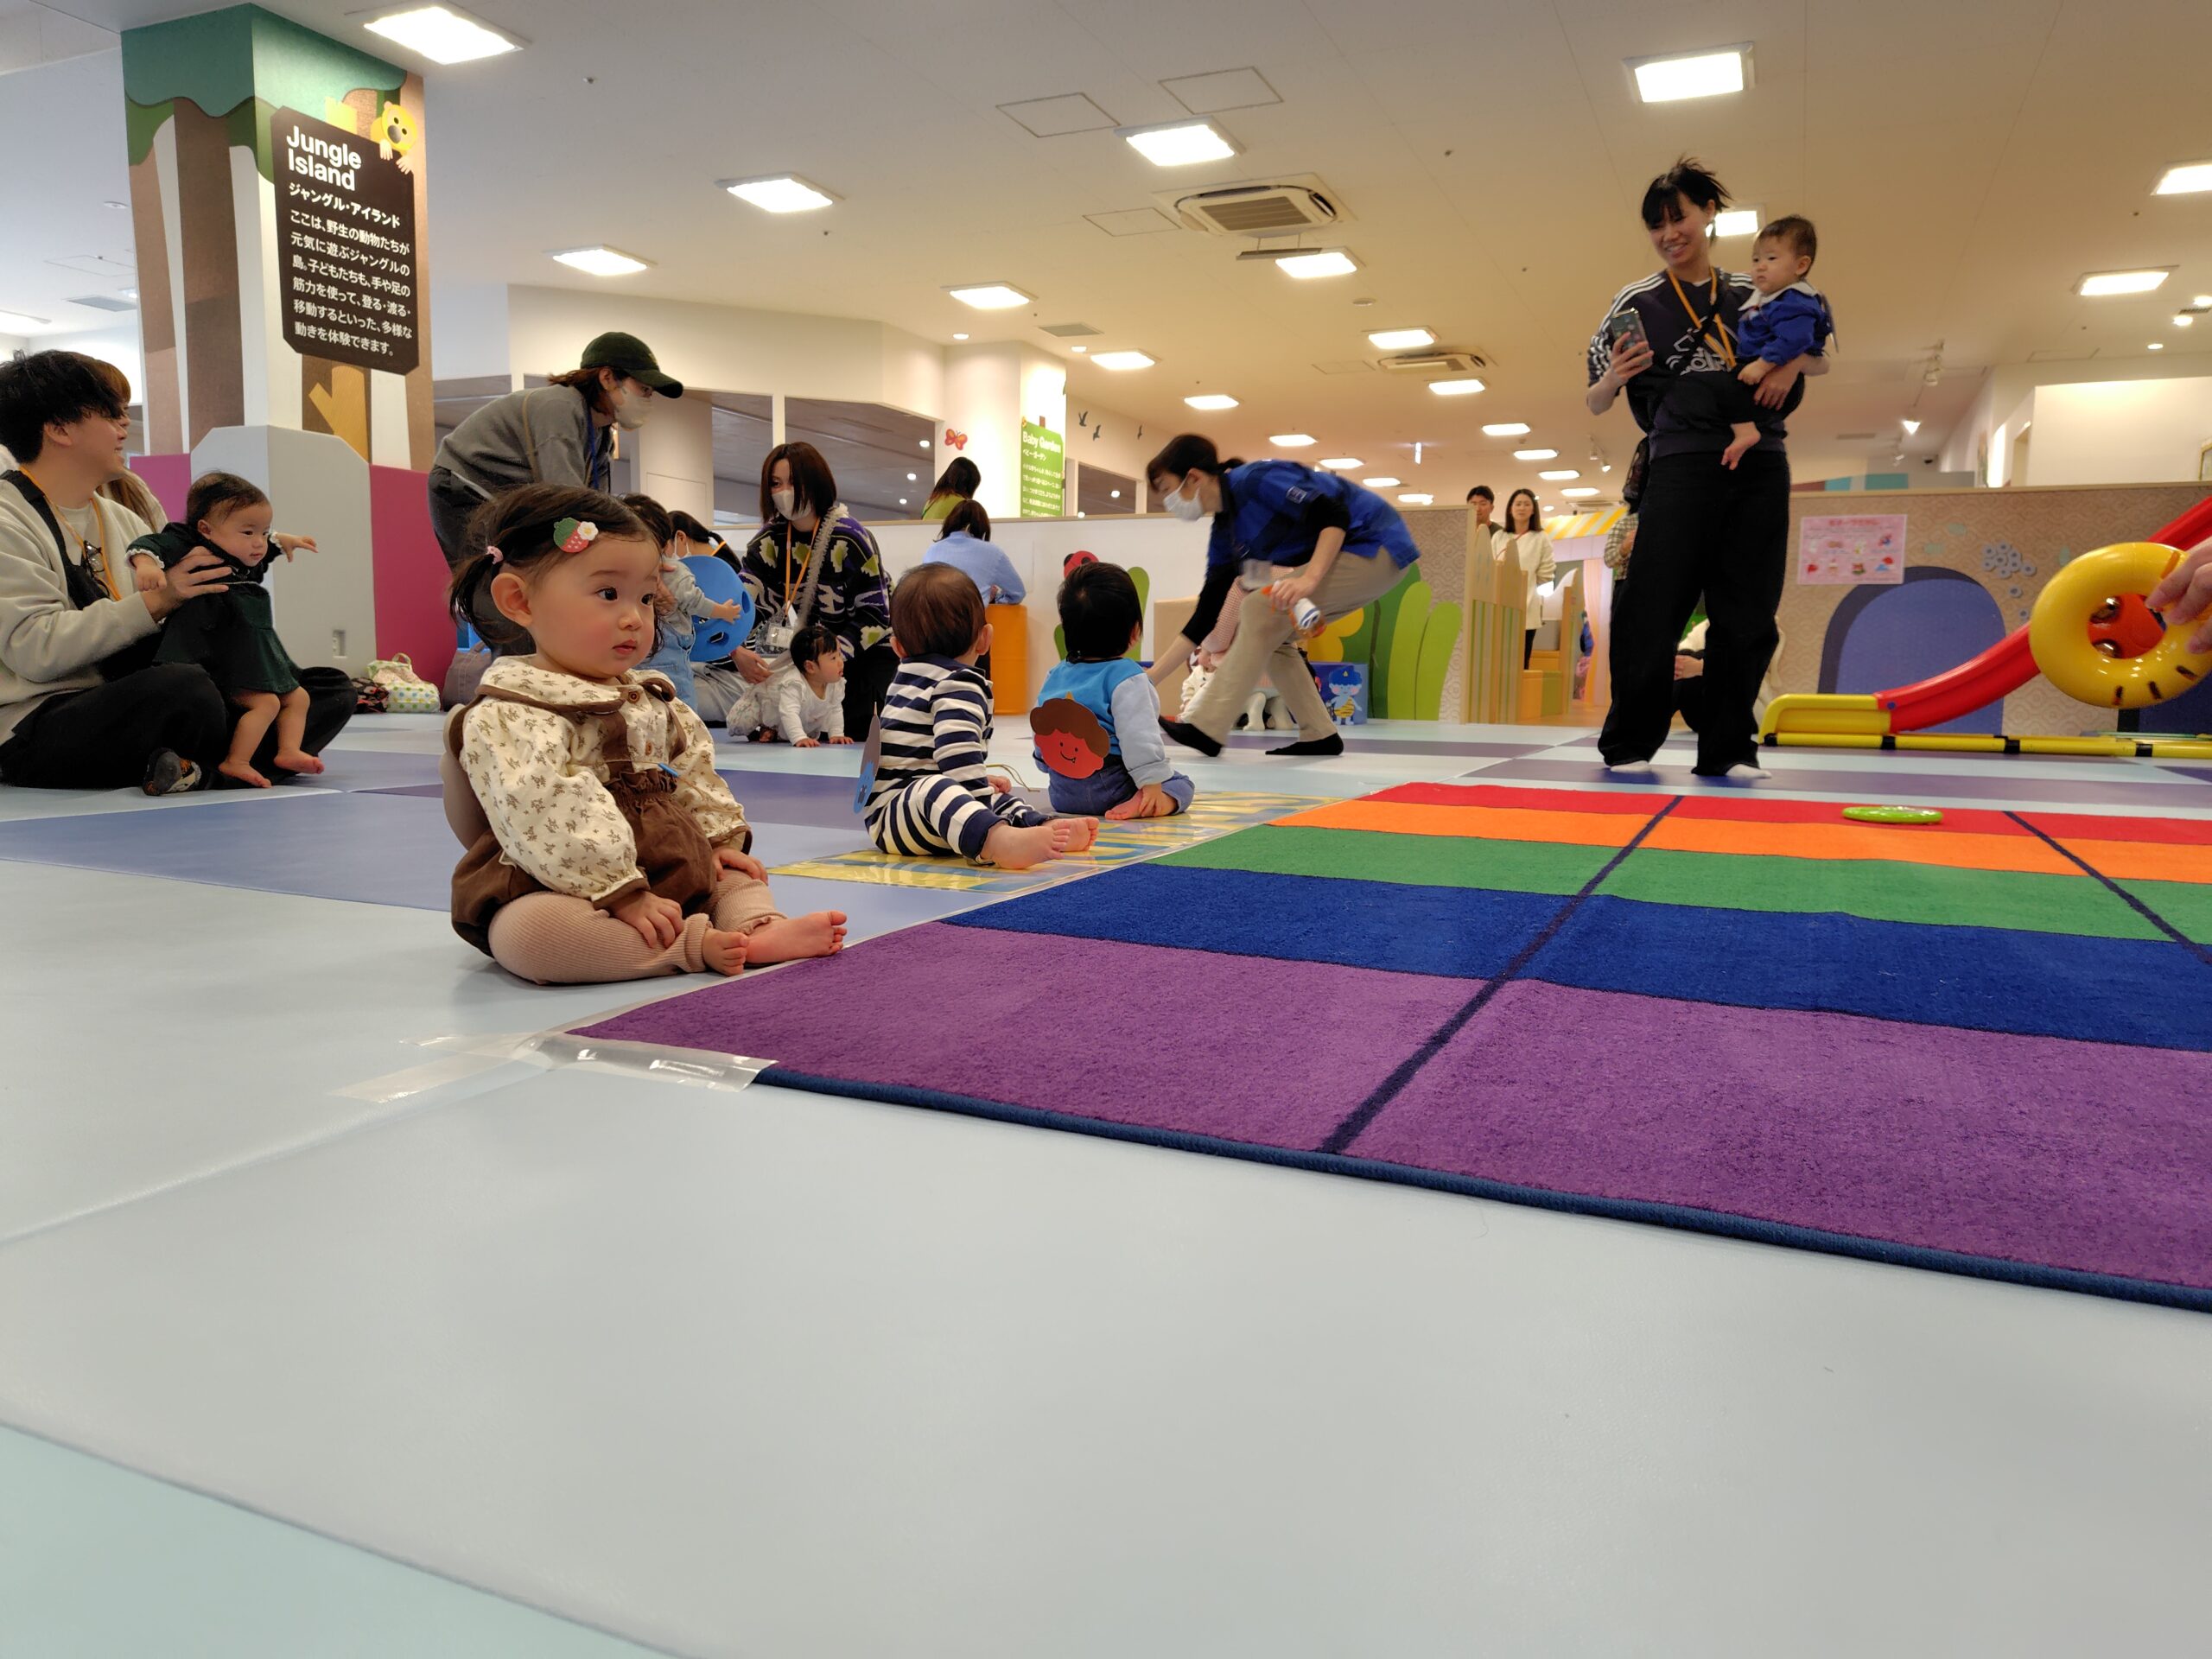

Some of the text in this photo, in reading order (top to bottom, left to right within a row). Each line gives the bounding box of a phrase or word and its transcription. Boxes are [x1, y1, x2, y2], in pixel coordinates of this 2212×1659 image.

[286, 125, 362, 169] Jungle
[288, 148, 355, 191] Island
[289, 182, 400, 228] ジャングル・アイランド
[290, 209, 410, 255] ここは、野生の動物たちが
[290, 232, 410, 276] 元気に遊ぶジャングルの
[292, 254, 411, 297] 島。子どもたちも、手や足の
[293, 276, 411, 317] 筋力を使って、登る・渡る・
[294, 299, 413, 340] 移動するといった、多様な
[295, 321, 394, 357] 動きを体験できます。
[1022, 430, 1039, 448] Baby
